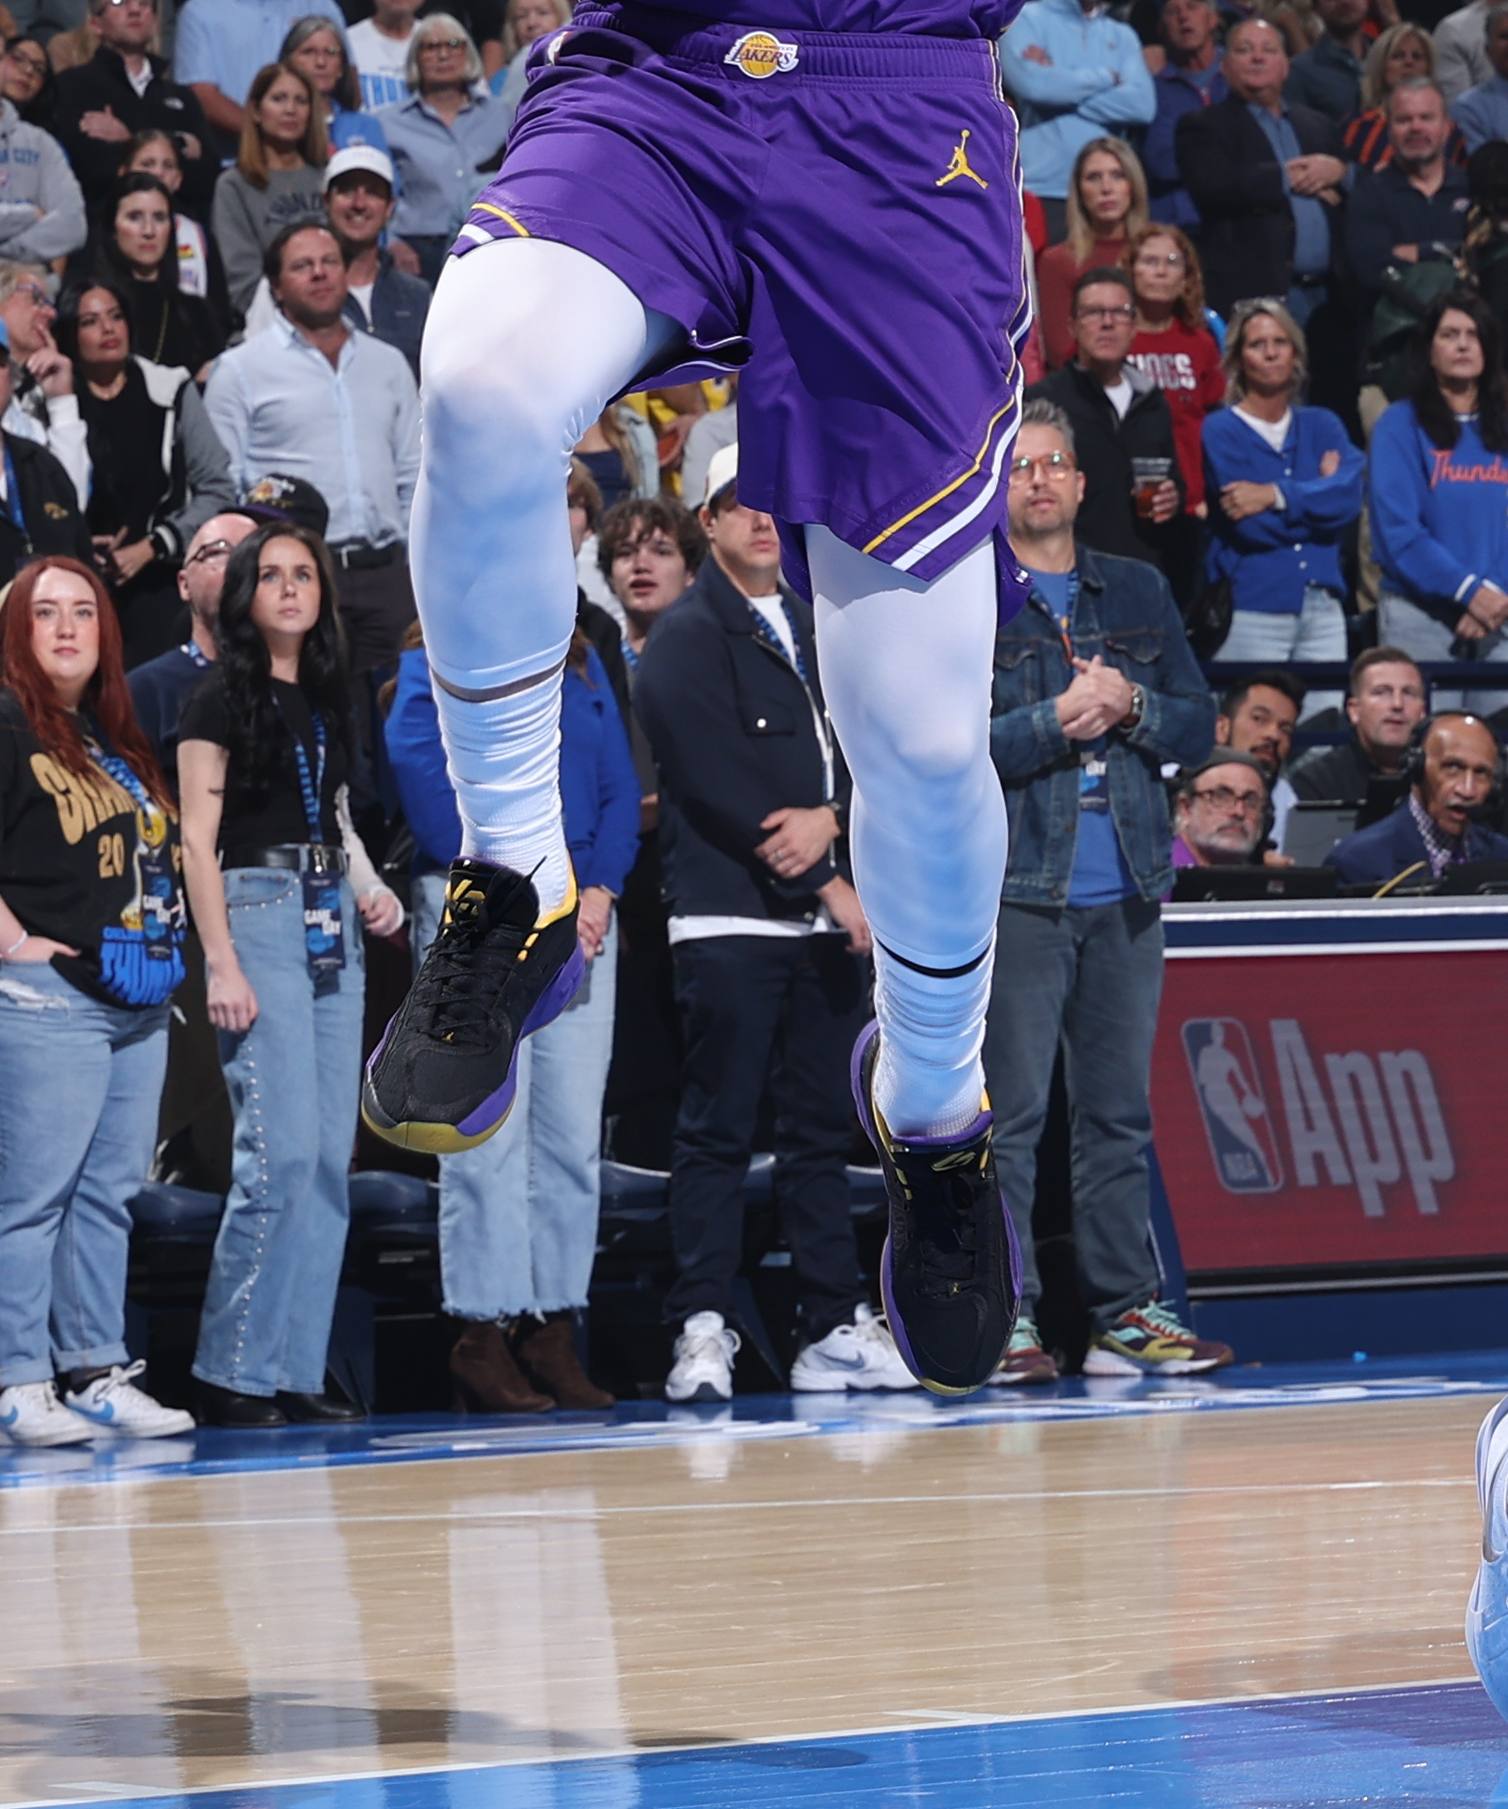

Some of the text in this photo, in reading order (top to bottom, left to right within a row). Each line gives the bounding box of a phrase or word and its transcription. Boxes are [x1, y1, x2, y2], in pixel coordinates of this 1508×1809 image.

[730, 40, 794, 67] LAKERS
[98, 833, 125, 878] 20
[142, 894, 165, 912] GAME
[156, 906, 172, 924] DAY
[303, 908, 332, 925] GAME
[321, 921, 342, 936] DAY
[1269, 1019, 1457, 1217] App
